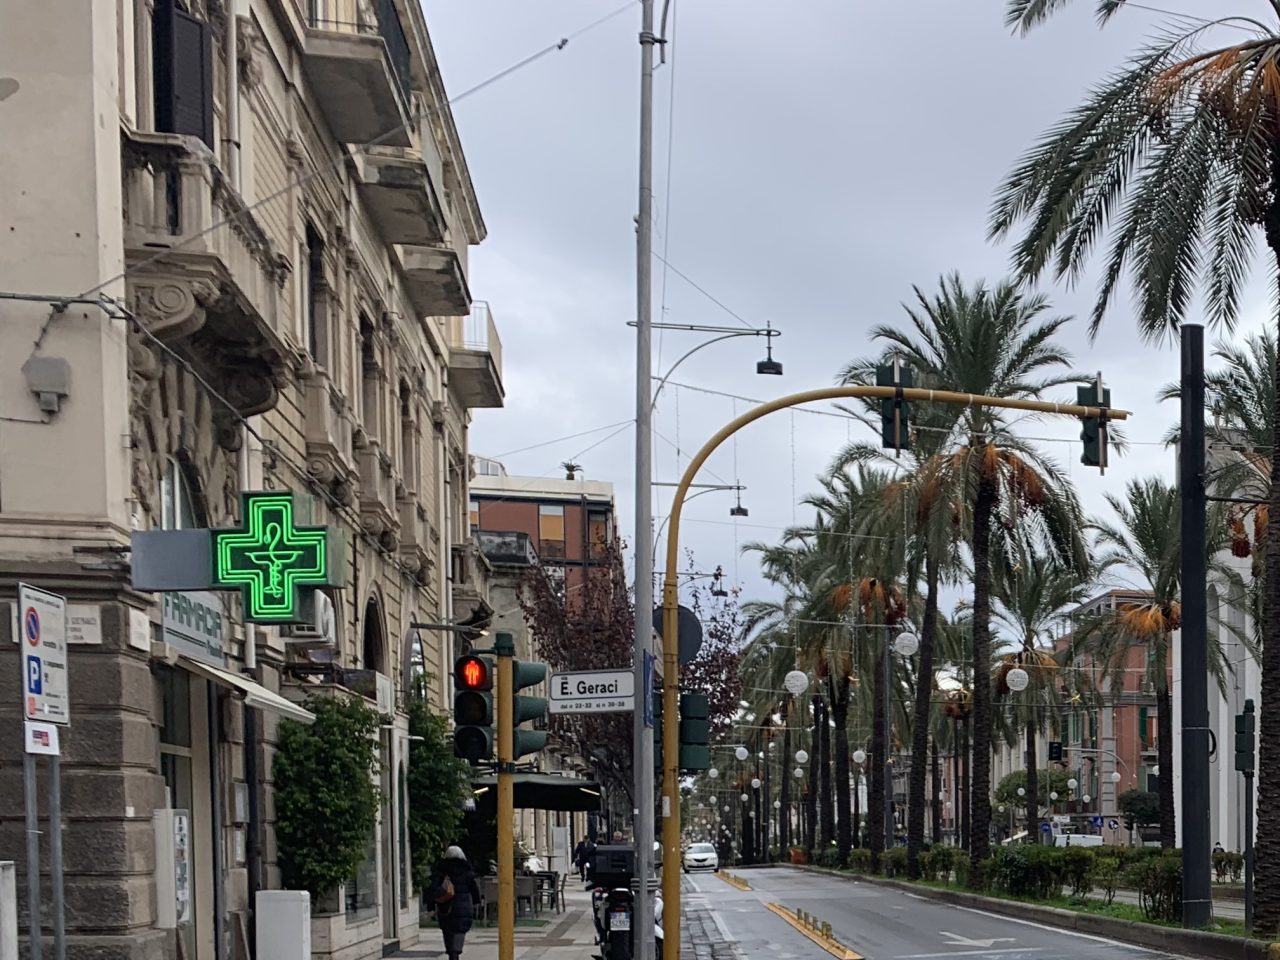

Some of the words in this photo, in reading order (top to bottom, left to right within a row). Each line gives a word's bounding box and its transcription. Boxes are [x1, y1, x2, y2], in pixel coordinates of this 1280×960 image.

[164, 591, 222, 641] FARMACIA
[561, 681, 572, 695] E.
[577, 680, 618, 695] Geraci
